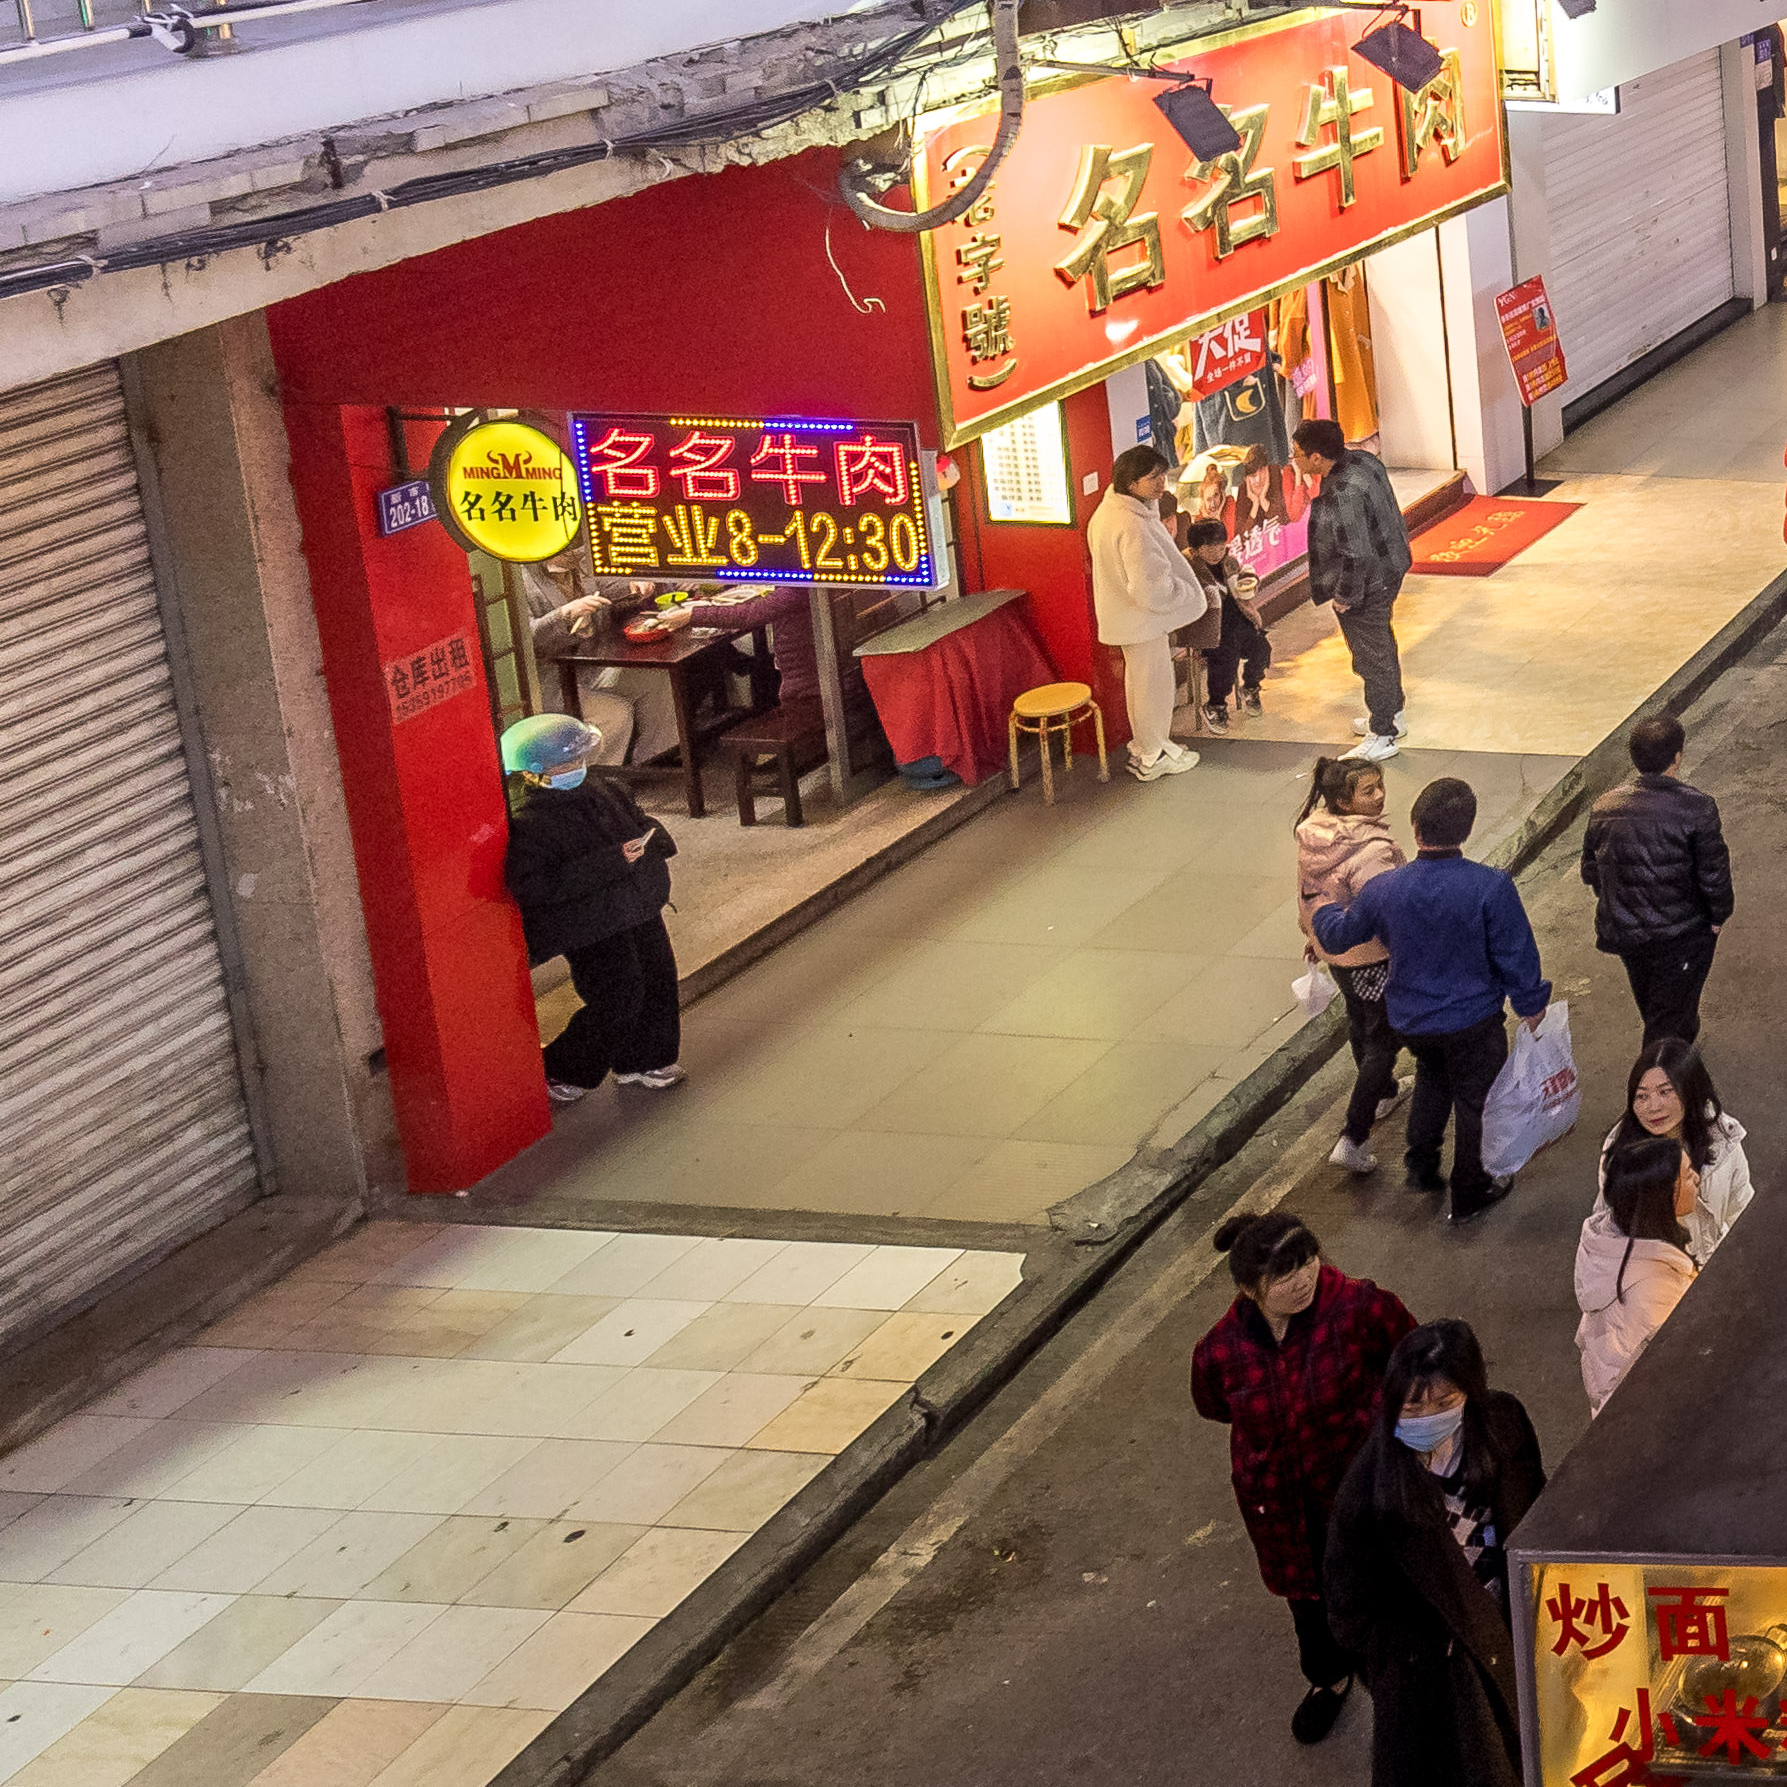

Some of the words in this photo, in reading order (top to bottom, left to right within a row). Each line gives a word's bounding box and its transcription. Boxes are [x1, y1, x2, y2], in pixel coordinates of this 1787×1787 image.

[460, 490, 578, 523] 名名牛肉
[590, 427, 910, 507] 名名牛肉
[1546, 1583, 1731, 1664] 炒面
